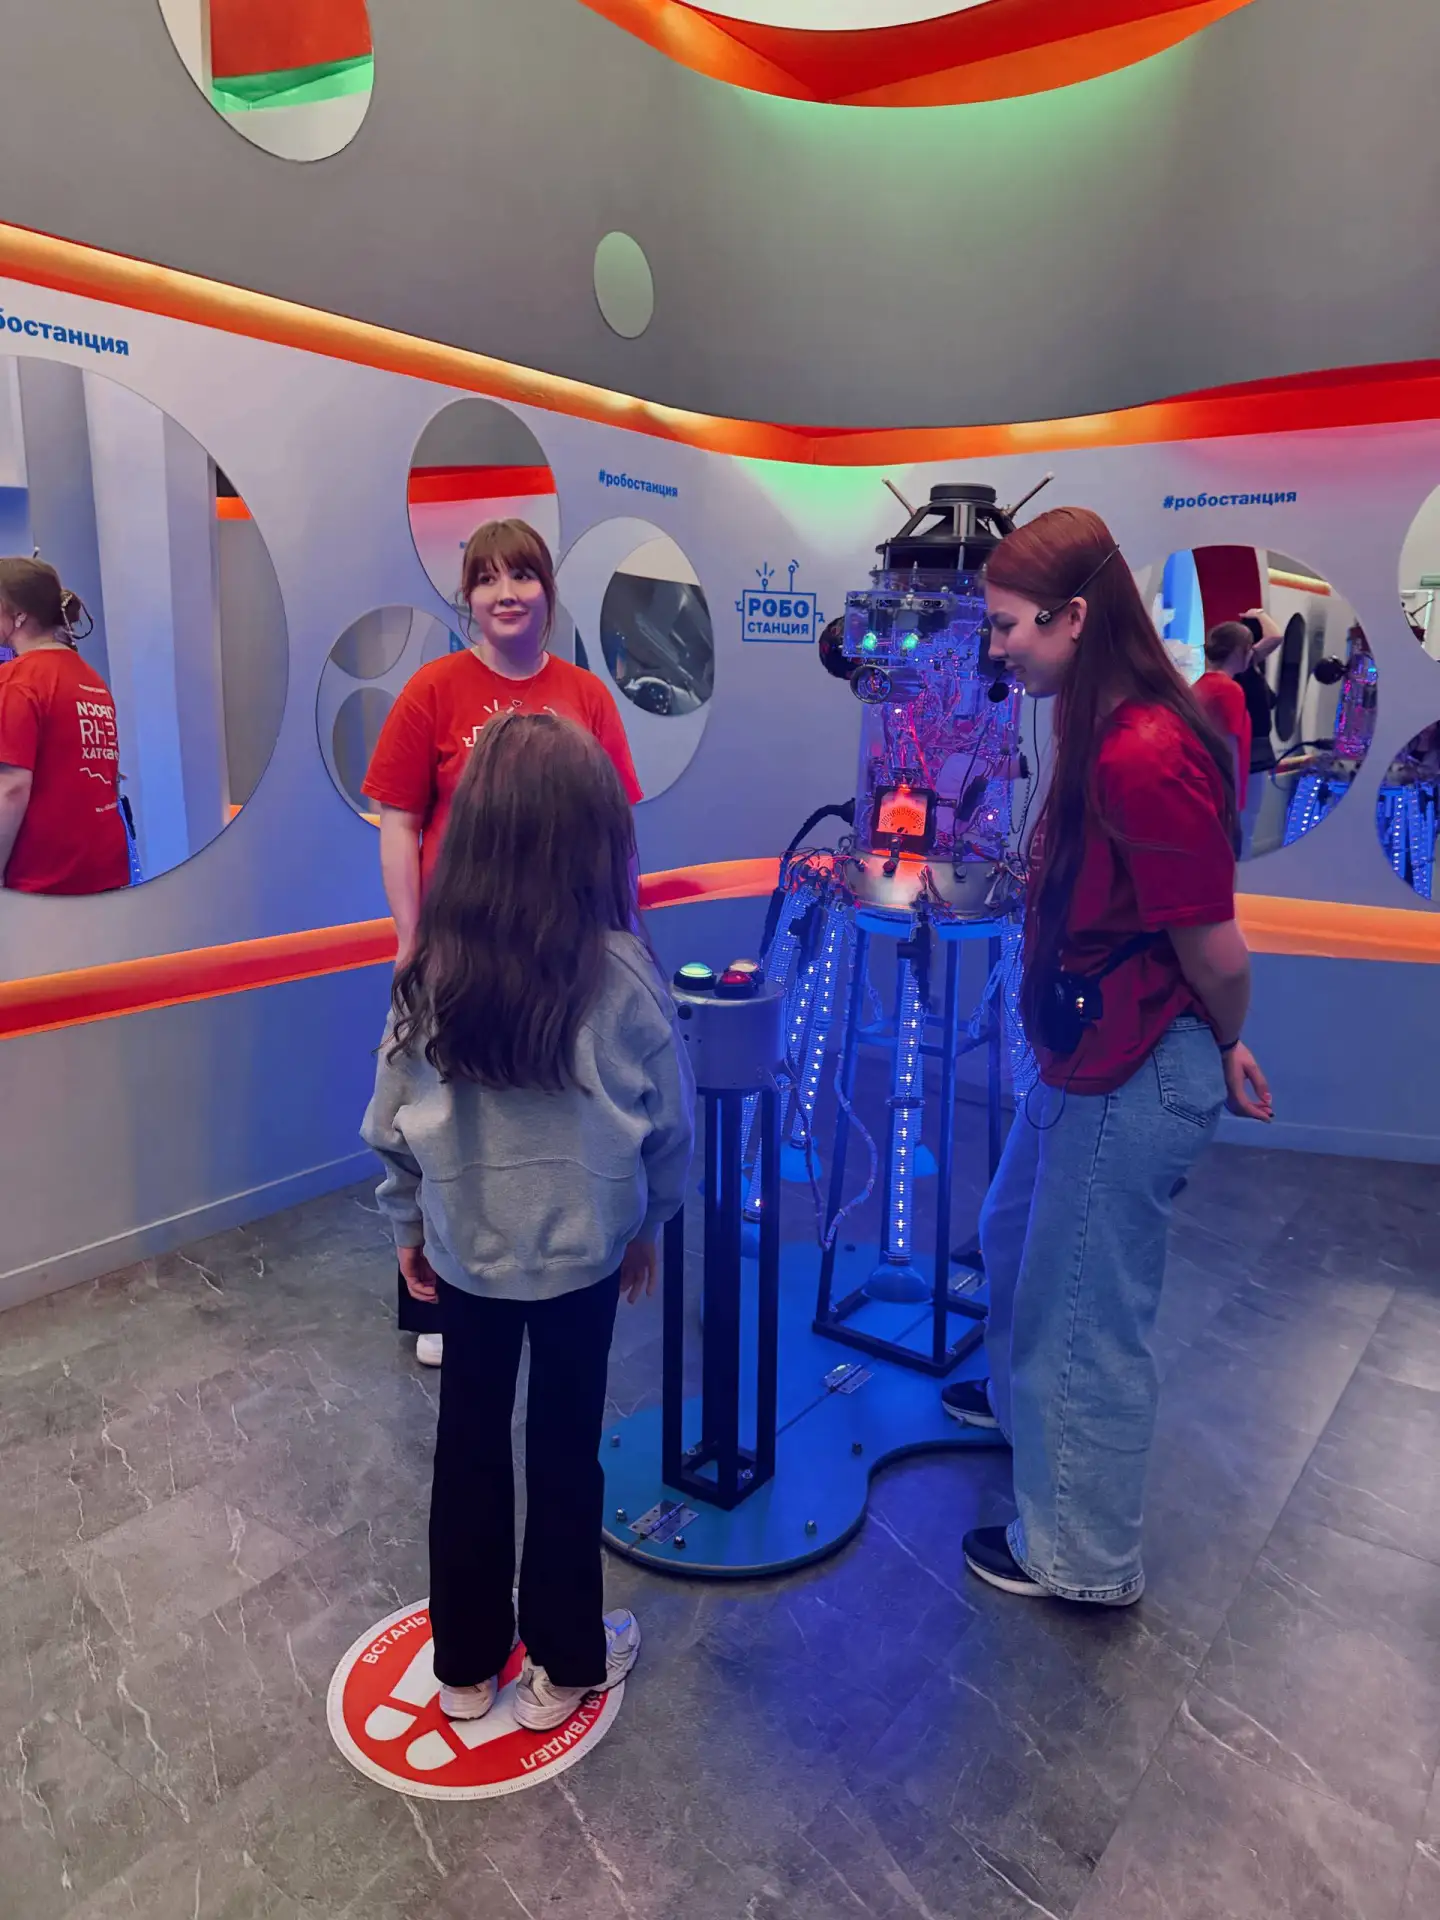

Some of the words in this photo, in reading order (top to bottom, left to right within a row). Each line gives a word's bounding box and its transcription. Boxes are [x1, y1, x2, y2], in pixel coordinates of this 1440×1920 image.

[599, 468, 678, 498] #робостанция
[1163, 491, 1297, 511] #робостанция
[748, 598, 809, 618] РОБО
[747, 621, 809, 635] СТАНЦИЯ
[362, 1616, 427, 1665] ВСТАНЬ
[520, 1711, 595, 1770] УВИДЕЛ
